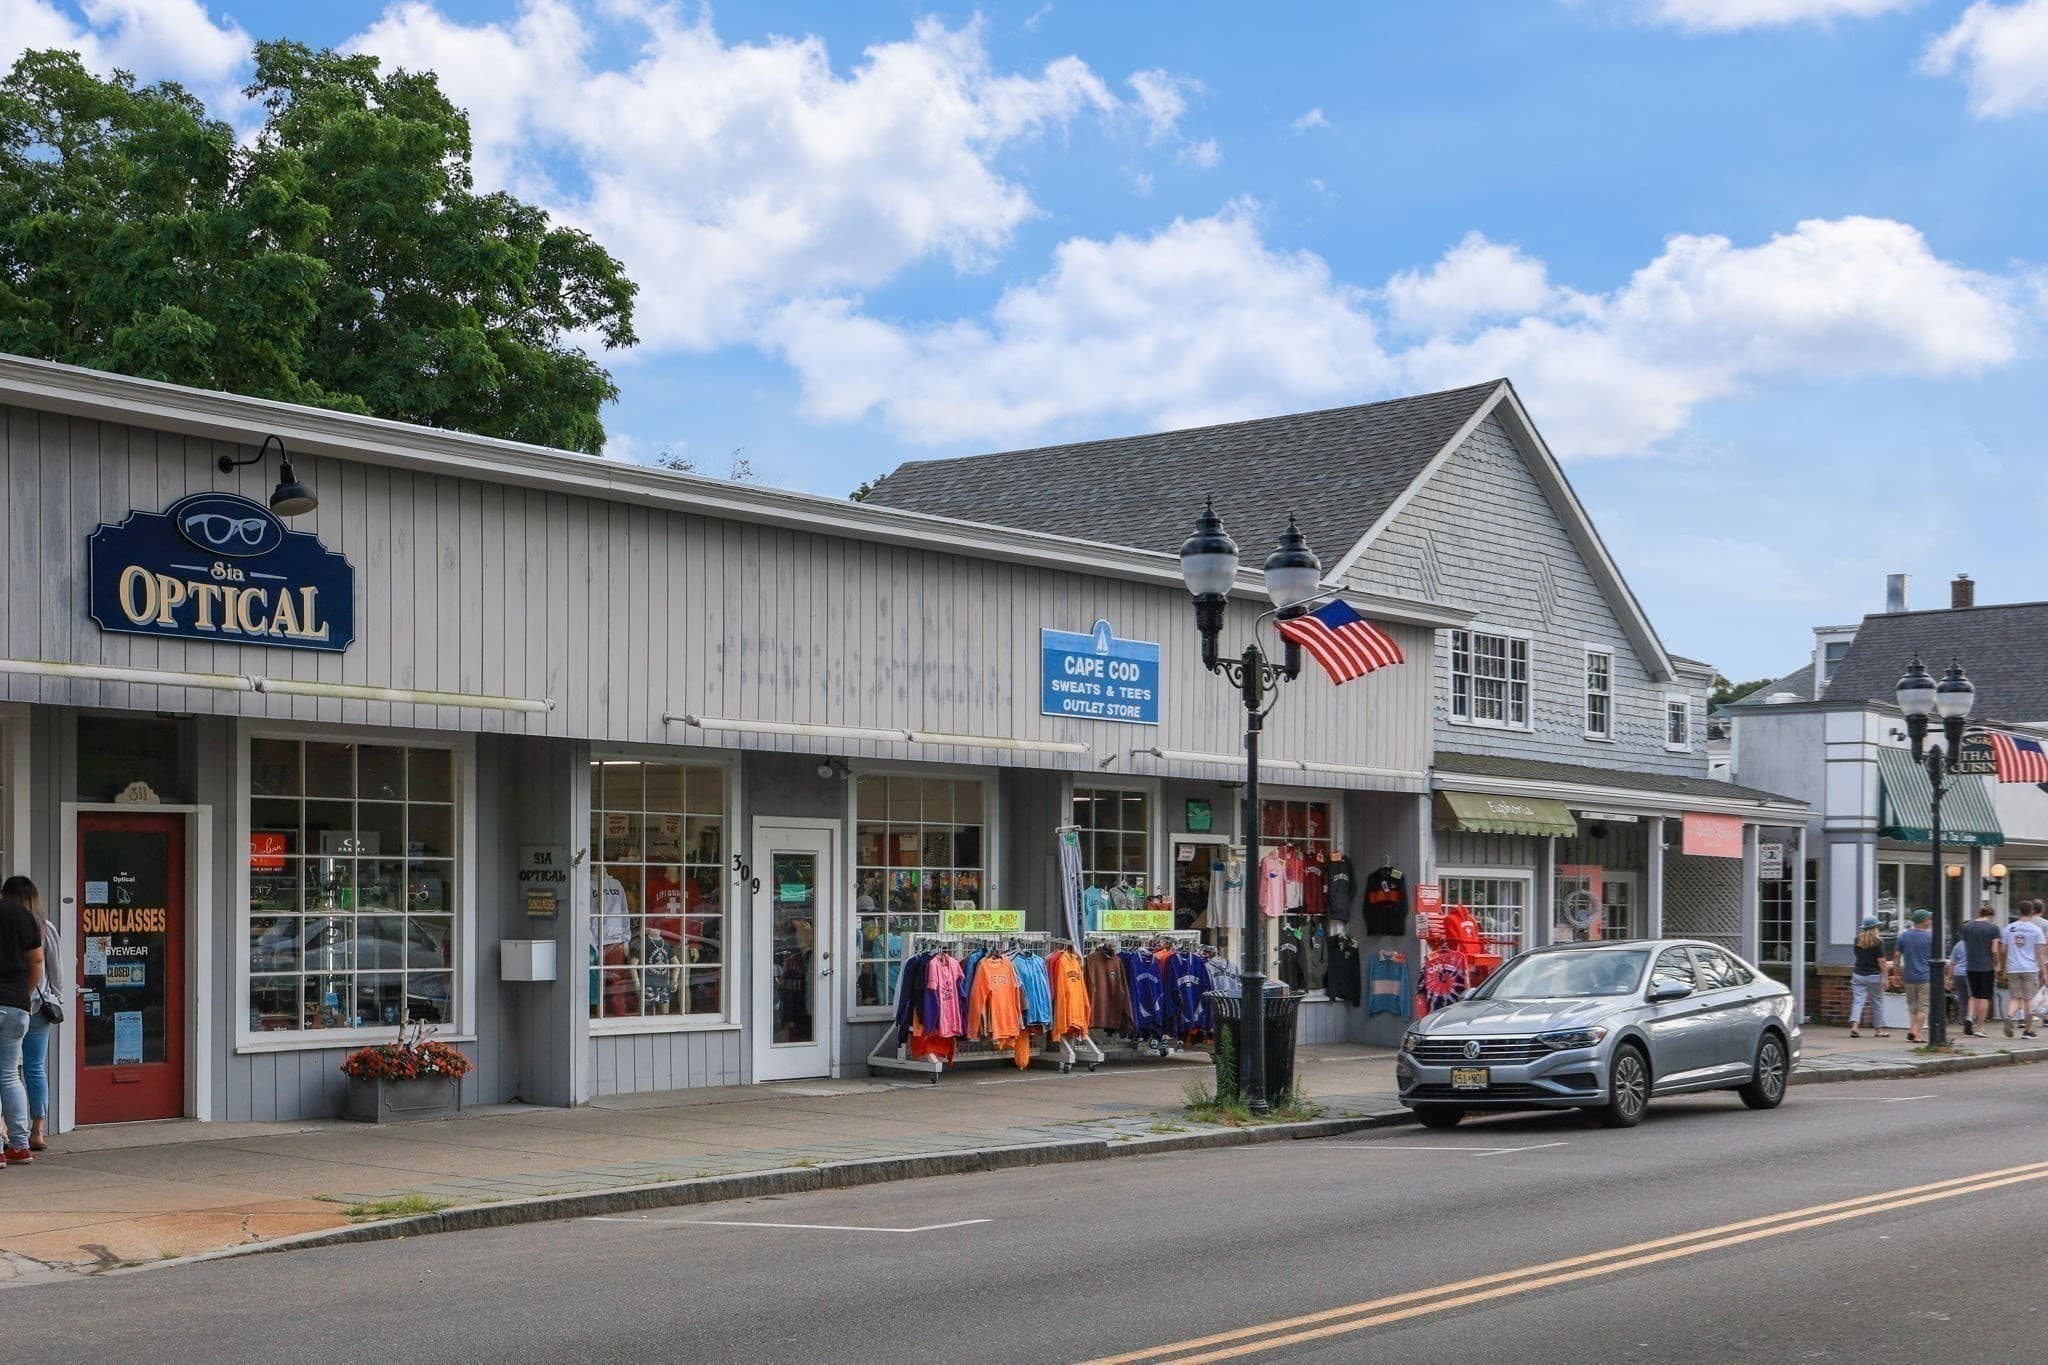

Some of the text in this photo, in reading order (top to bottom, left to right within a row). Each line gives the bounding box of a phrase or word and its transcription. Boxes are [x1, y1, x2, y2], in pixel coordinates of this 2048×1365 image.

[210, 561, 245, 582] Sia
[119, 564, 329, 641] OPTICAL
[1064, 655, 1140, 681] CAPE COD
[1051, 679, 1101, 695] SWEATS
[1106, 685, 1115, 697] &
[1063, 699, 1141, 718] OUTLET STORE
[1950, 762, 1997, 773] CUISIN
[534, 851, 553, 865] SIA
[112, 876, 136, 884] Optical
[519, 869, 567, 882] OPTICAL
[732, 854, 761, 895] 309
[83, 907, 167, 933] SUNGLASSES
[106, 966, 130, 978] CLOSED
